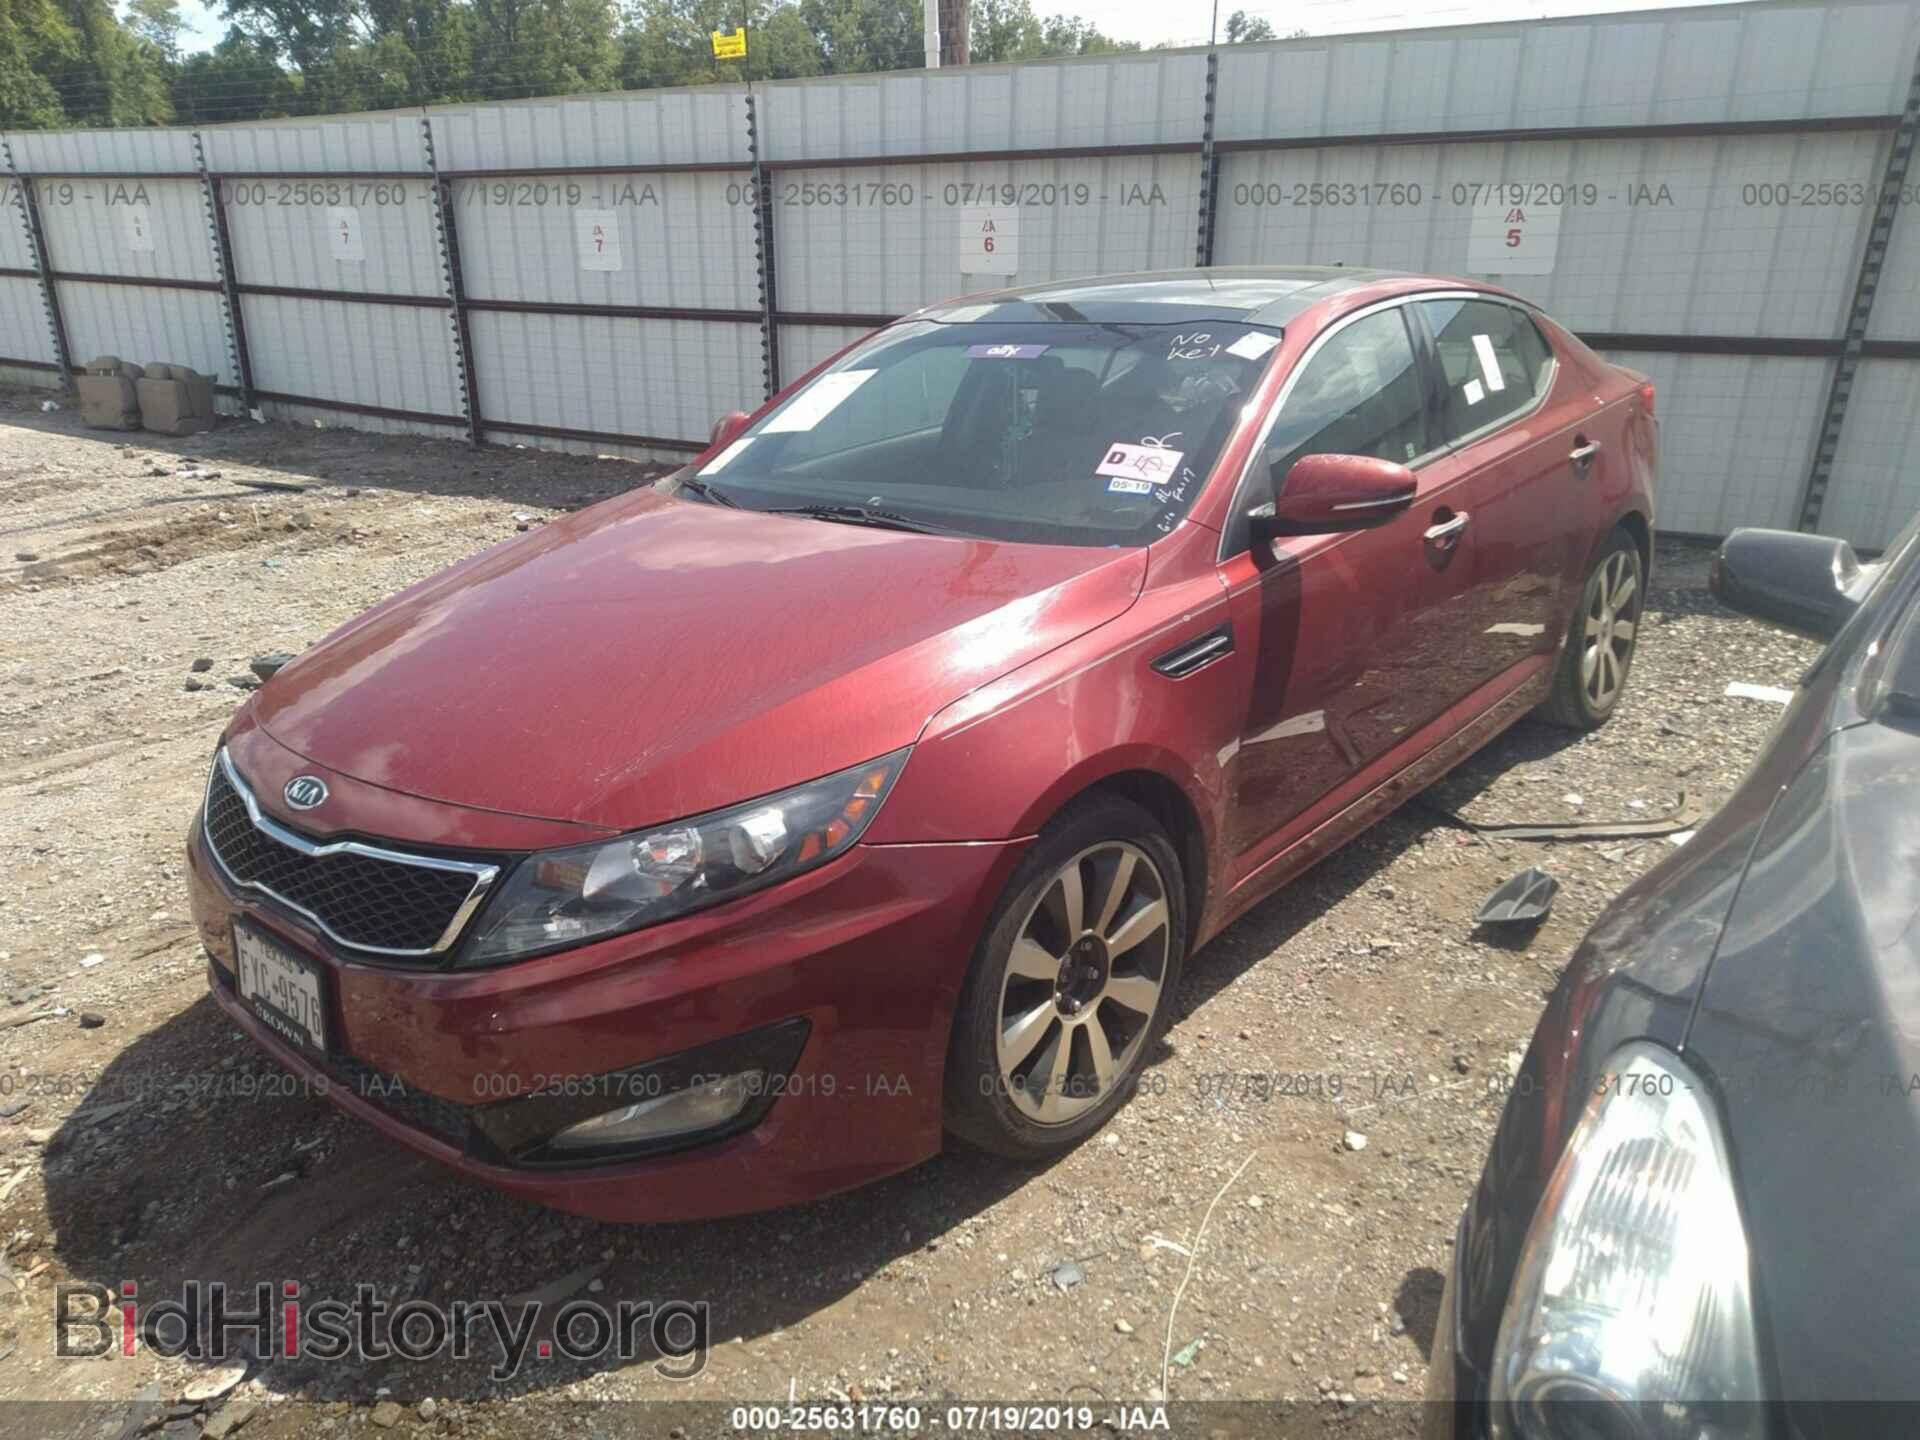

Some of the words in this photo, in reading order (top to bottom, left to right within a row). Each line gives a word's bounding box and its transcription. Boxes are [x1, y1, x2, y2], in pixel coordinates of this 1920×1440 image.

[595, 239, 604, 252] 7
[984, 236, 995, 252] 6
[1505, 229, 1522, 247] 5
[1106, 451, 1127, 465] D
[288, 779, 319, 806] KIA
